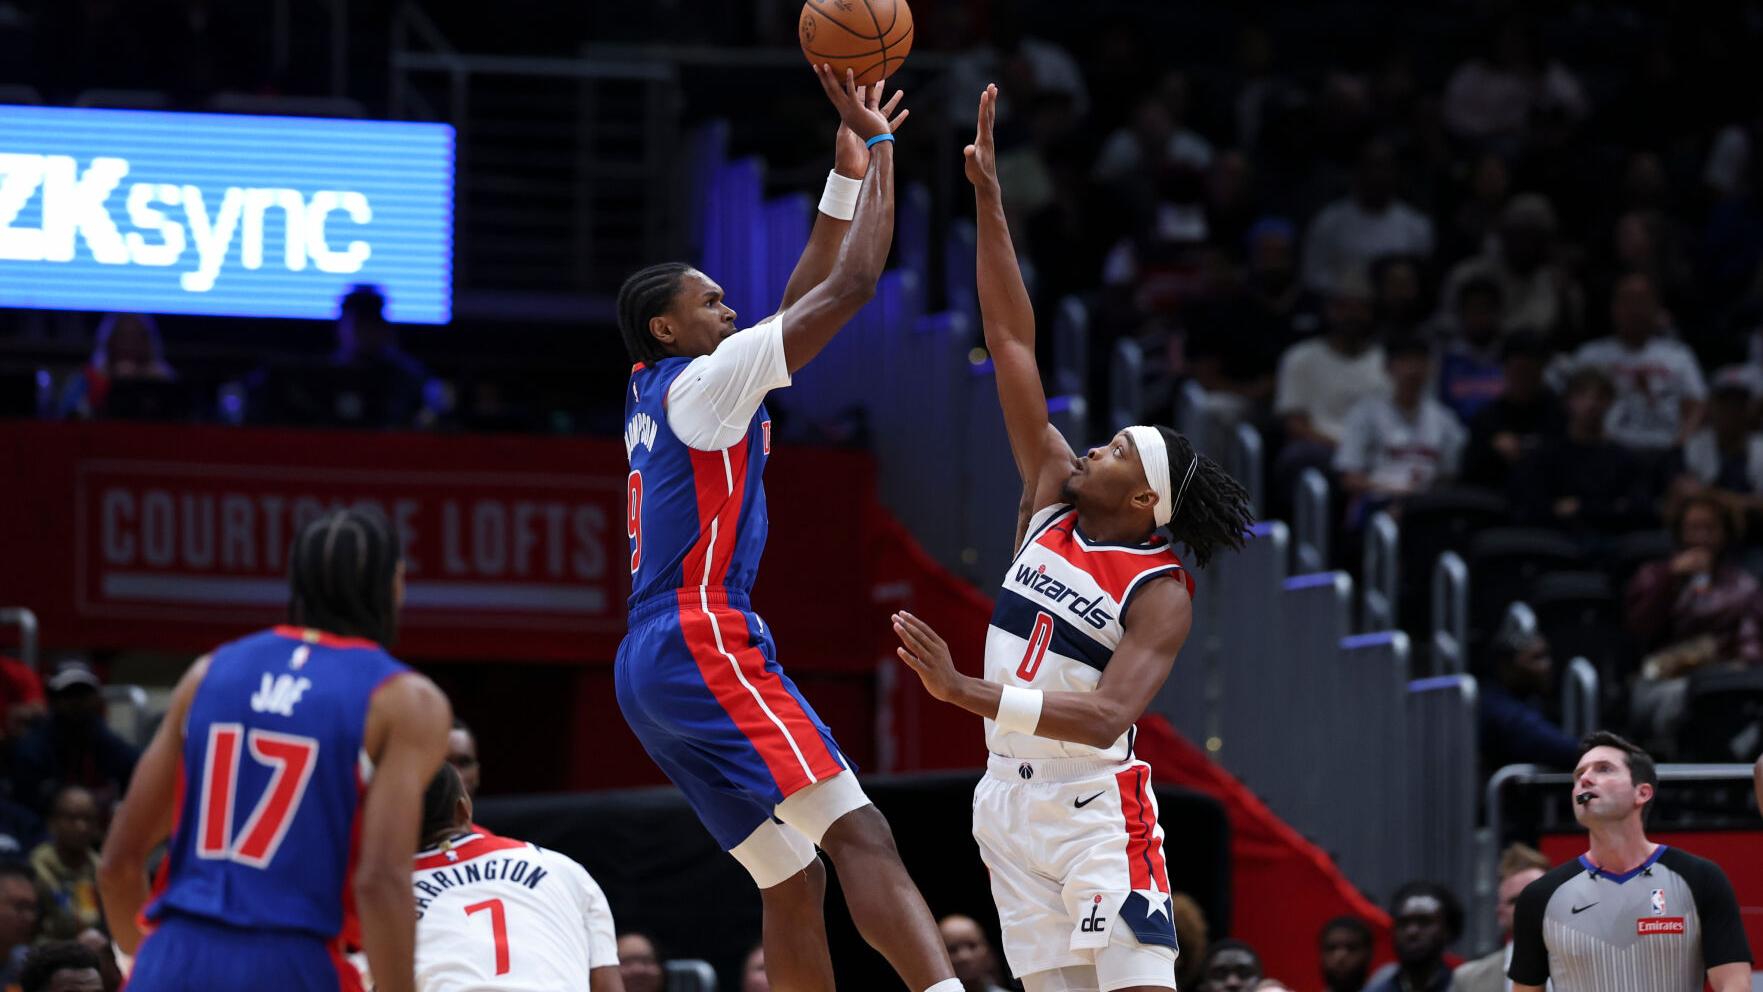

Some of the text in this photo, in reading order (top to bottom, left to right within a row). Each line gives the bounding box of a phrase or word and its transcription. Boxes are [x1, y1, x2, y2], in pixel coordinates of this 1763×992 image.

[0, 153, 372, 291] ZKsync
[624, 412, 658, 466] OMPSON
[102, 487, 609, 579] COURTE LOFTS
[627, 469, 643, 574] 9
[1015, 563, 1114, 630] wizards
[1015, 610, 1054, 683] 0
[250, 672, 311, 716] JOE
[197, 722, 319, 869] 17
[463, 898, 511, 976] 7
[1638, 920, 1684, 932] Emirates
